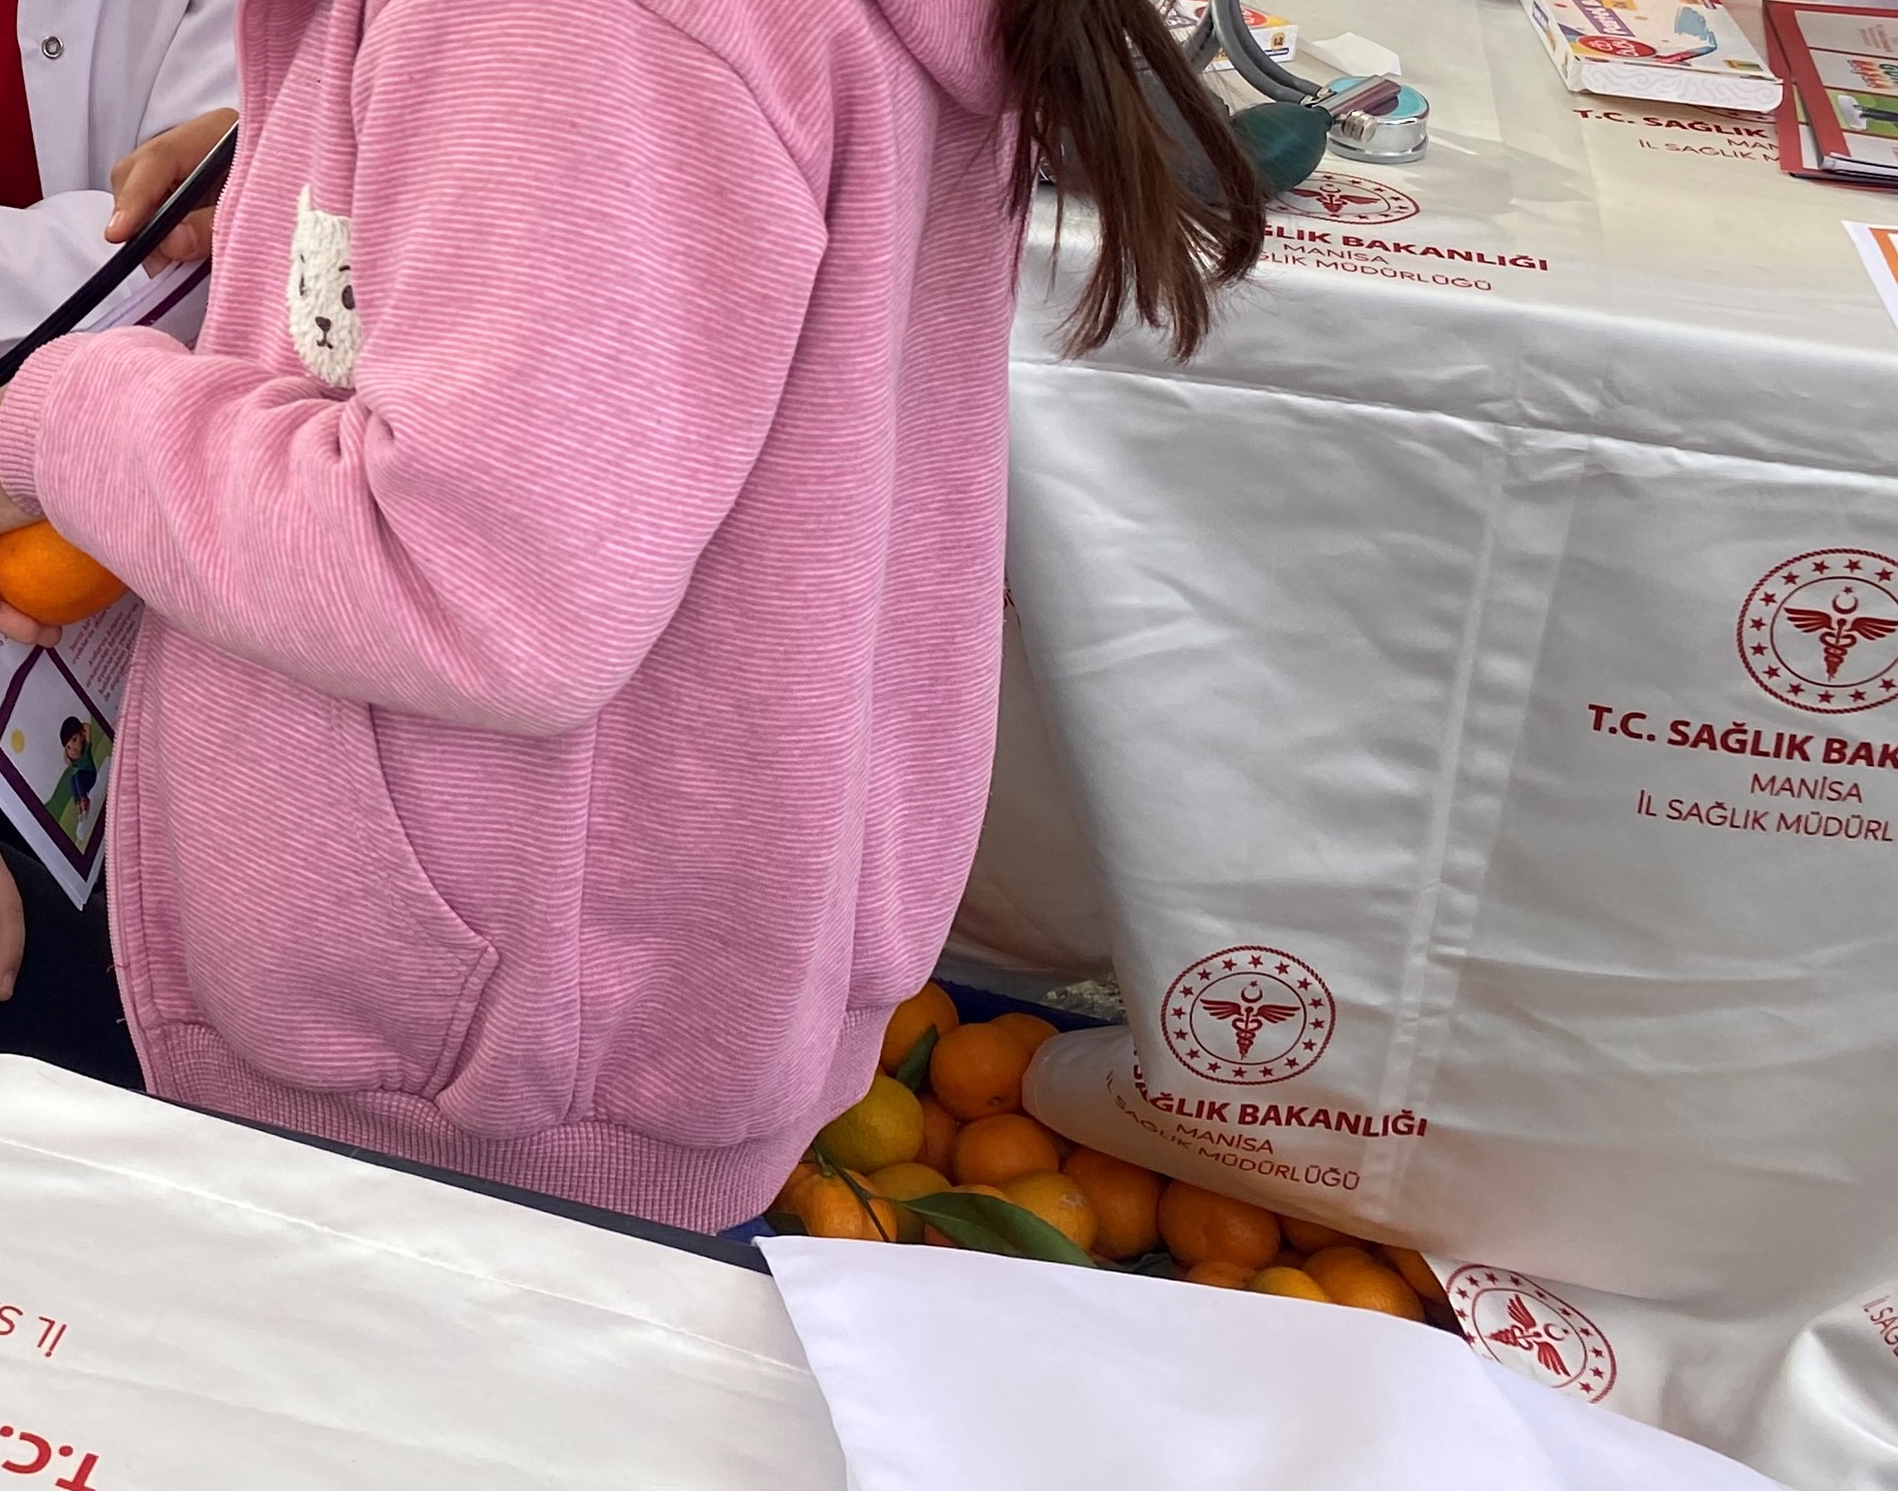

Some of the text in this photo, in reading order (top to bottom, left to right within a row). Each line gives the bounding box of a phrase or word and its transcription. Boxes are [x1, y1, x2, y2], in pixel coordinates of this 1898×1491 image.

[1572, 109, 1635, 125] T.C.
[1283, 242, 1390, 265] MANİSA
[1342, 235, 1550, 271] BAKANLIĞI
[1315, 259, 1494, 292] MÜDÜRLÜĞÜ
[1588, 703, 1657, 742] T.C.
[1666, 719, 1815, 762] SAĞLIK
[1749, 773, 1863, 804] MANİSA
[1636, 789, 1894, 842] İL SAĞLIK MÜDÜRL
[1237, 1103, 1428, 1138] BAKANLIĞI
[1175, 1123, 1274, 1155] MANİSA
[1197, 1145, 1361, 1191] MÜDÜRLÜĞÜ
[36, 1314, 68, 1358] İL
